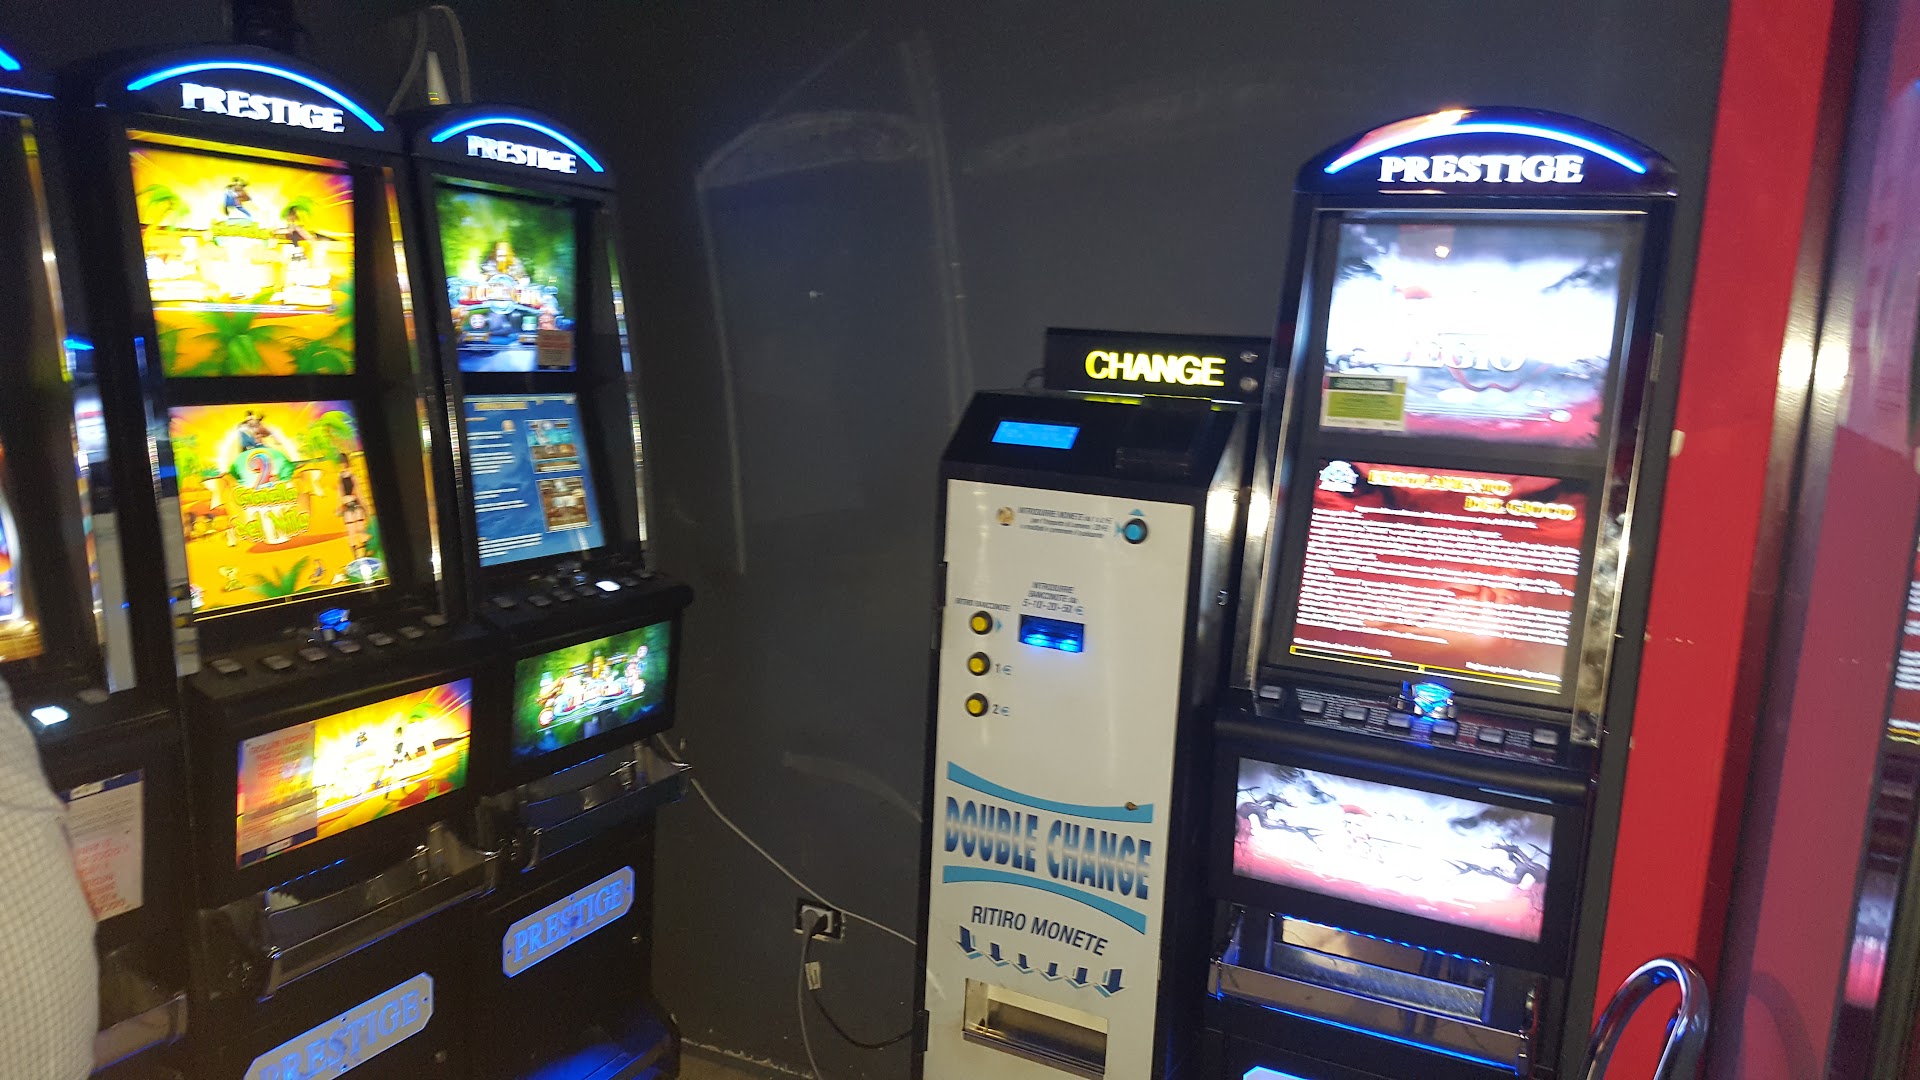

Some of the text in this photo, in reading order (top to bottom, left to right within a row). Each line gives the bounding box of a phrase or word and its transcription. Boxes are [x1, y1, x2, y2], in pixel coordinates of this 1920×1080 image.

[180, 82, 345, 133] PRESTIGE
[466, 135, 577, 174] PRESTIGE
[1378, 154, 1584, 184] PRESTIGE
[1085, 350, 1226, 387] CHANGE
[944, 796, 1152, 900] DOUBLE CHANGE
[513, 878, 625, 964] PRESTIGE
[971, 906, 1108, 957] RITIRO MONETE
